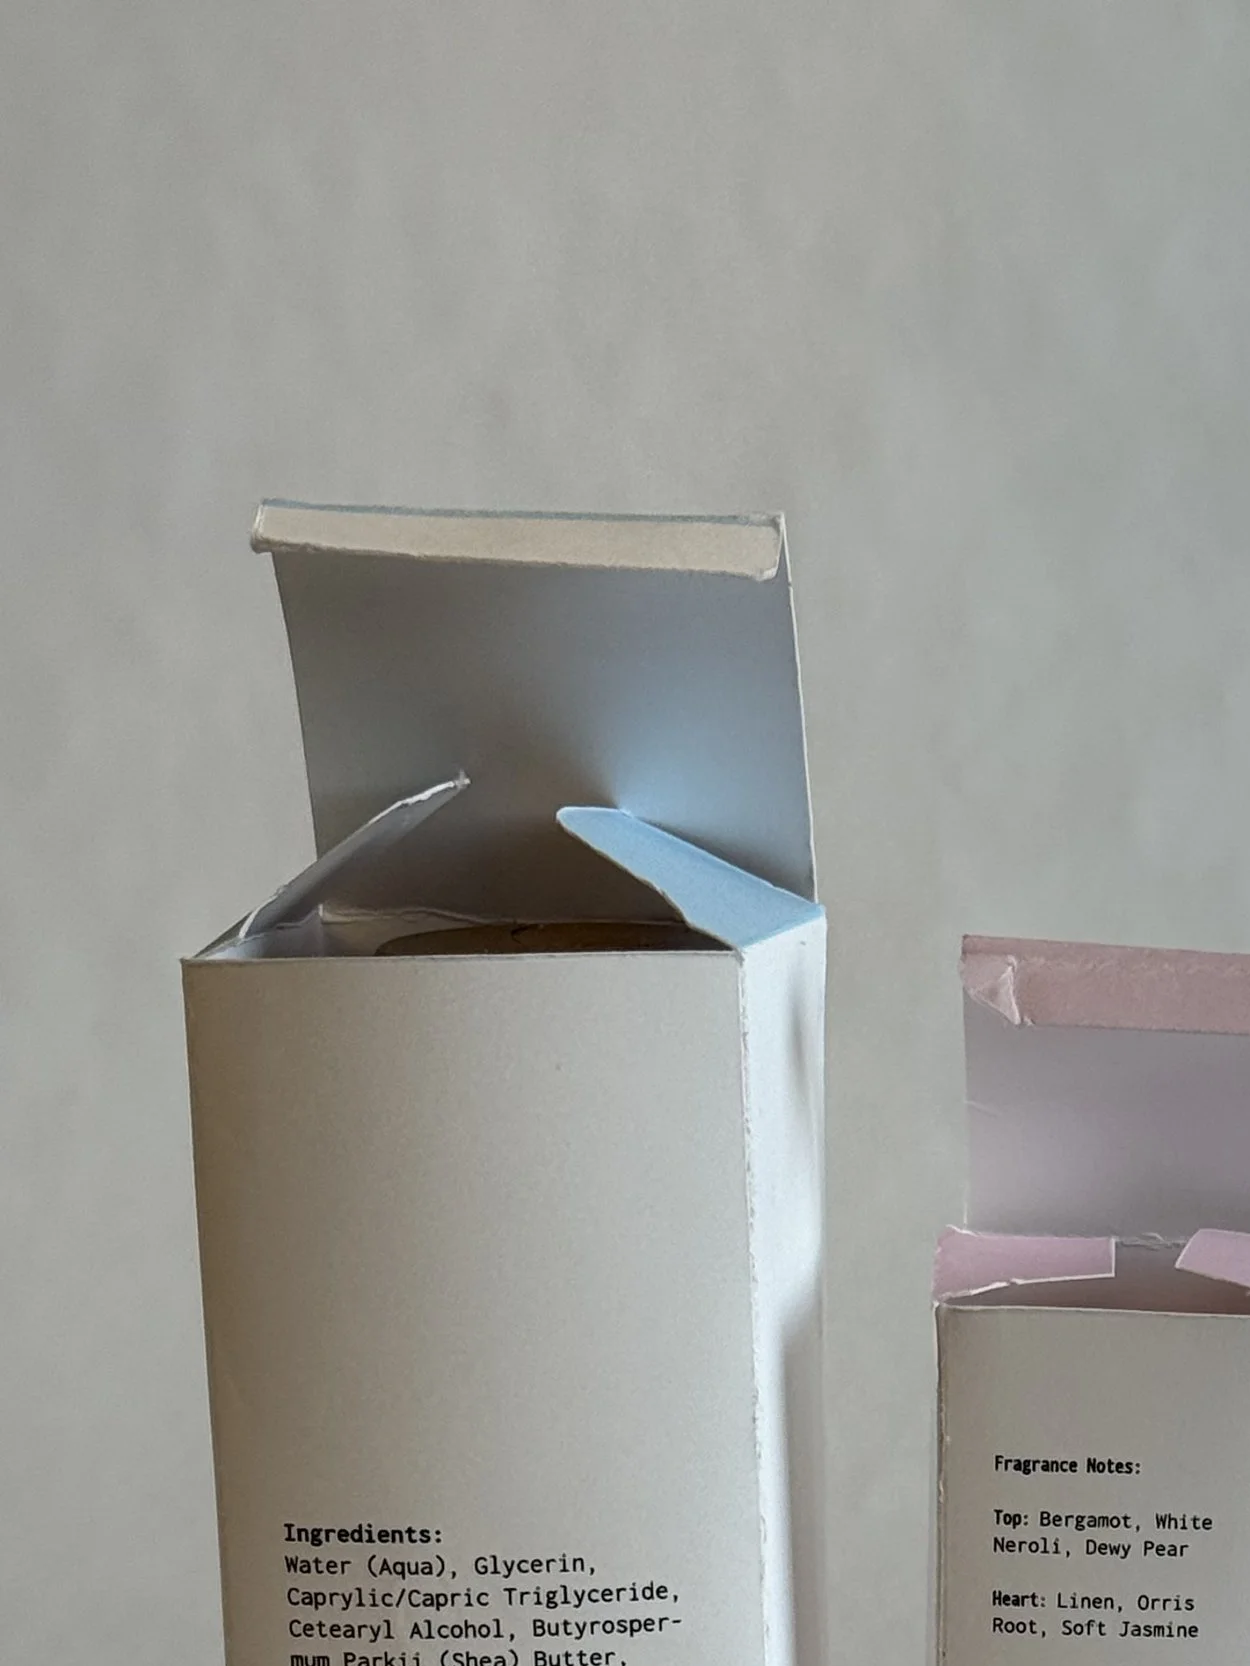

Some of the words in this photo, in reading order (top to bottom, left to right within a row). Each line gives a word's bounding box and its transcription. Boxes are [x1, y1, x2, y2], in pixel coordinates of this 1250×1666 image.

[995, 1455, 1078, 1475] Fragrance
[1086, 1457, 1140, 1475] Notes:
[993, 1509, 1028, 1529] Top:
[1040, 1511, 1140, 1533] Bergamot,
[1155, 1513, 1212, 1530] White
[284, 1523, 442, 1547] Ingredients:
[993, 1536, 1070, 1558] Neroli,
[1086, 1539, 1131, 1559] Dewy
[1144, 1540, 1189, 1557] Pear
[284, 1555, 352, 1575] Water
[367, 1554, 456, 1580] (Aqua),
[474, 1553, 595, 1579] Glycerin,
[287, 1587, 489, 1612] Caprylic/Capric
[503, 1580, 678, 1609] Triglyceride,
[992, 1590, 1045, 1607] Heart:
[1057, 1592, 1122, 1613] Linen,
[1137, 1594, 1195, 1611] Orris
[289, 1619, 395, 1643] Cetearyl
[409, 1618, 515, 1642] Alcohol,
[532, 1617, 682, 1640] Butyrosper-
[993, 1617, 1046, 1638] Root,
[1061, 1619, 1107, 1636] Soft
[1119, 1621, 1199, 1638] Jasmine
